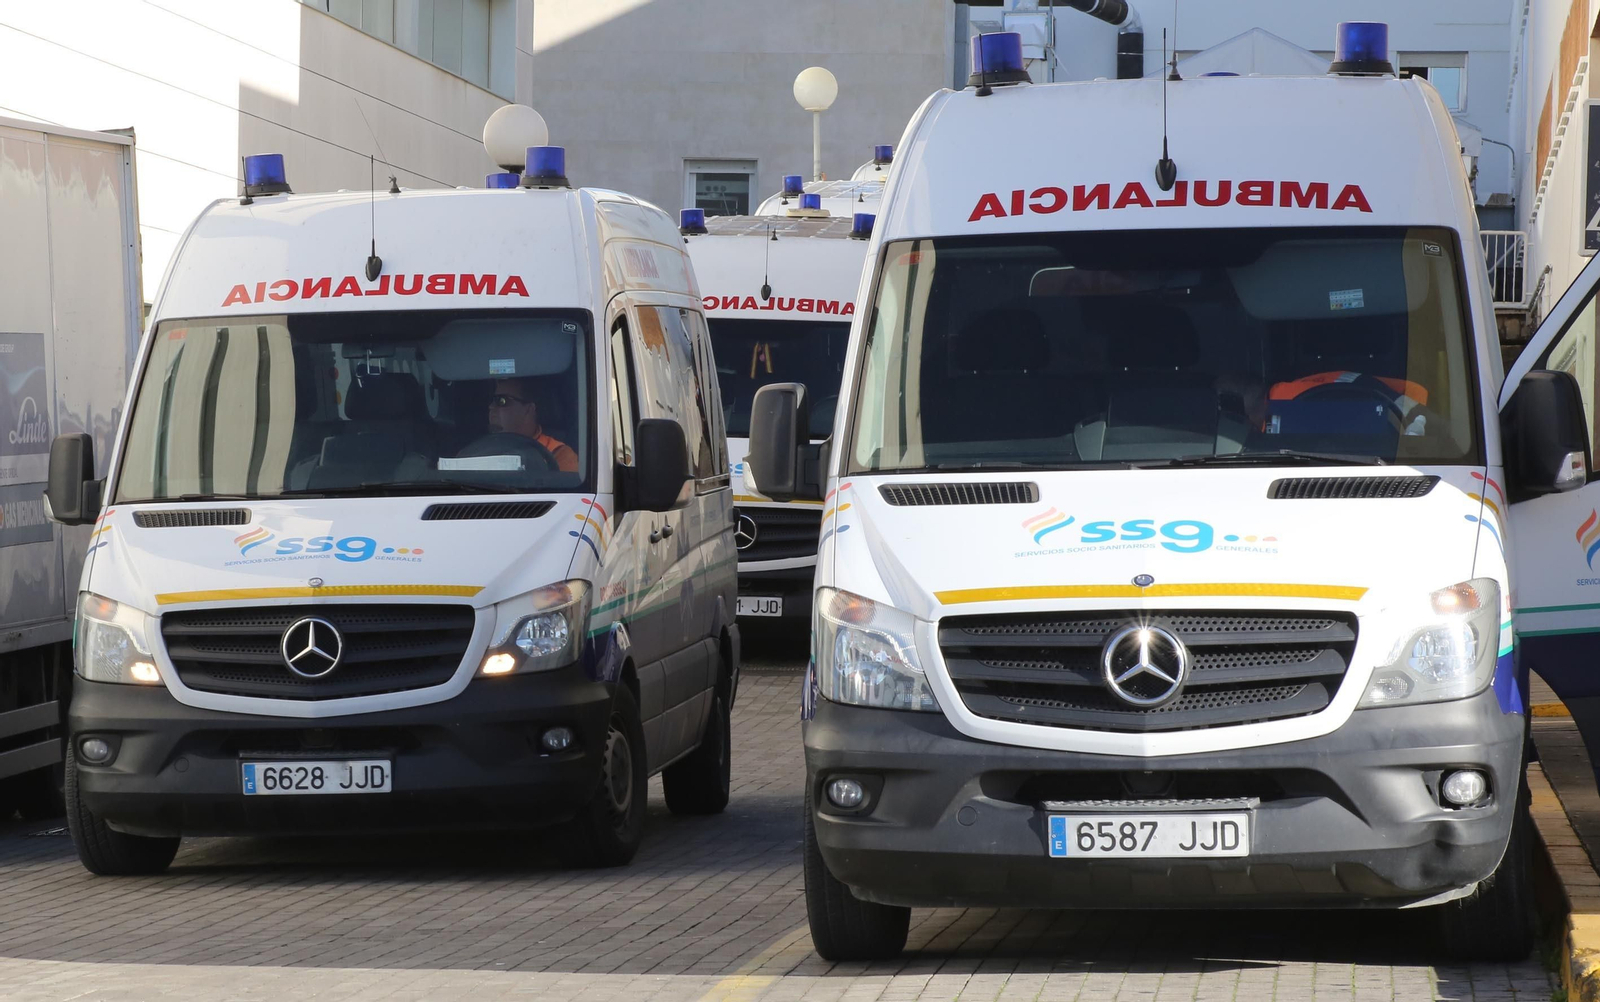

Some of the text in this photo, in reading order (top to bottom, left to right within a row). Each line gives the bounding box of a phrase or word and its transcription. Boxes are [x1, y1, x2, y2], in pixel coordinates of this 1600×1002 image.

[9, 396, 47, 444] Linde
[5, 502, 16, 528] GAS
[1081, 519, 1214, 553] ssg
[224, 559, 262, 567] SERVICIOS
[375, 555, 422, 563] GENERALES
[275, 536, 377, 562] ssg
[1014, 548, 1064, 558] SERVICIOS
[1100, 543, 1156, 551] SANITARIOS
[1215, 544, 1279, 554] GENERALES
[751, 600, 778, 614] JJD
[263, 765, 385, 790] 6628 JJD
[1055, 841, 1063, 850] E
[1076, 820, 1239, 852] 6587 JJD
